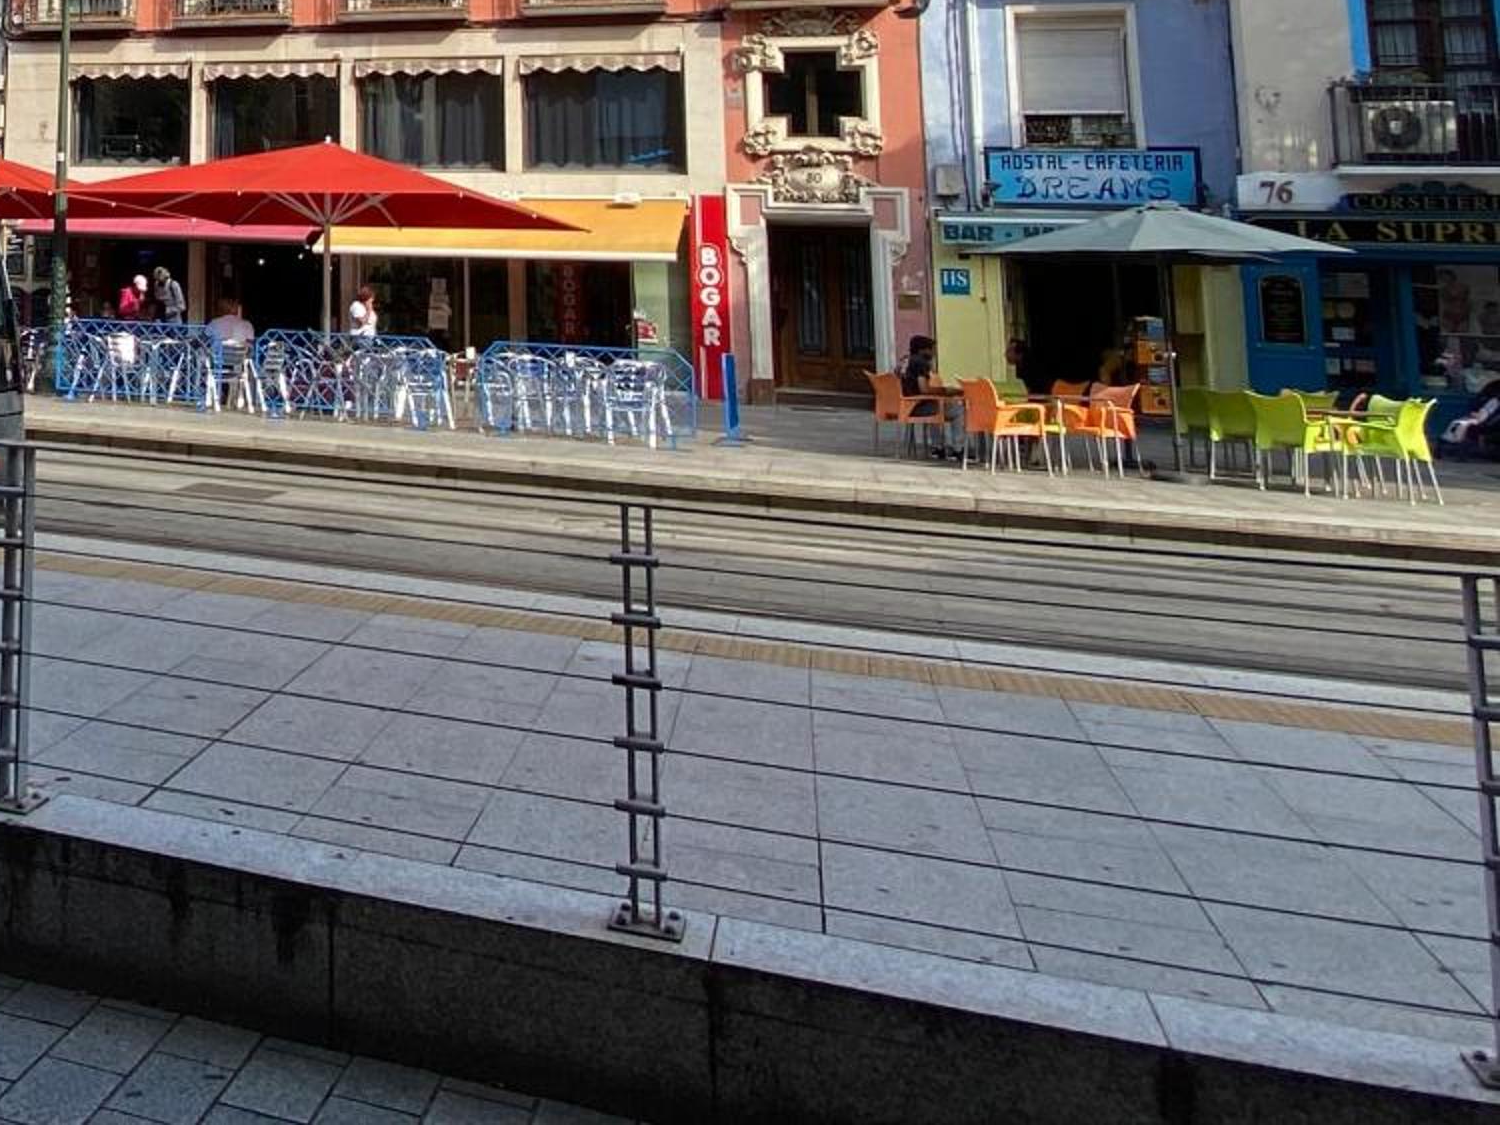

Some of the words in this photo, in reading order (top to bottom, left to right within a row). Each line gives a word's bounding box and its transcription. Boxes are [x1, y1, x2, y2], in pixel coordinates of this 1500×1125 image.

[1001, 154, 1066, 171] HOSTAL
[1085, 154, 1183, 172] CAFETERIA
[1015, 176, 1171, 200] DREAMS
[1259, 180, 1293, 204] 76
[943, 225, 994, 241] BAR
[1295, 220, 1349, 241] LA
[699, 246, 723, 347] BOGAR
